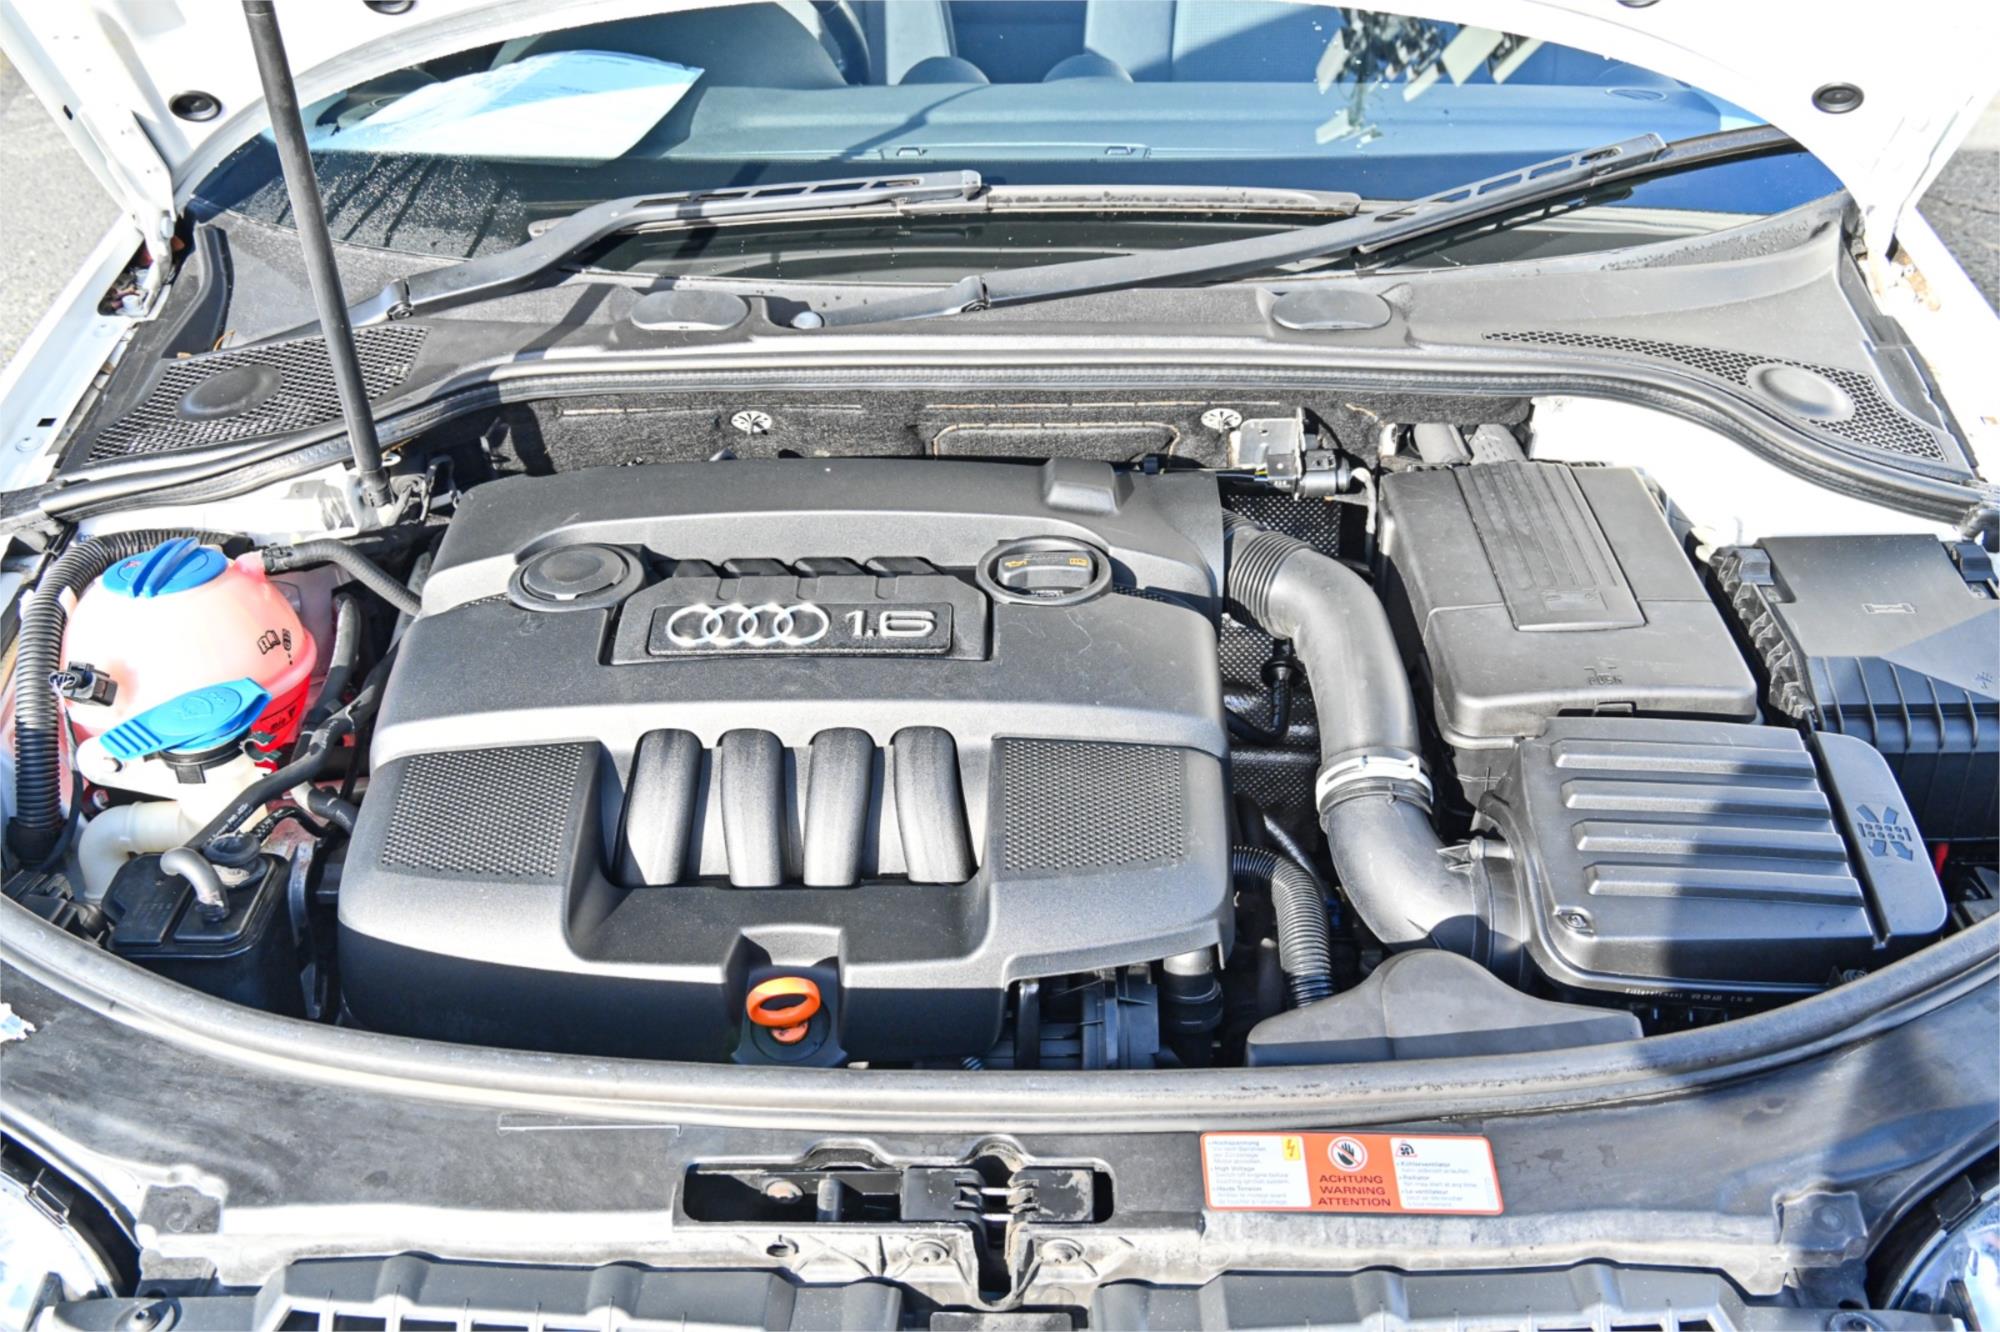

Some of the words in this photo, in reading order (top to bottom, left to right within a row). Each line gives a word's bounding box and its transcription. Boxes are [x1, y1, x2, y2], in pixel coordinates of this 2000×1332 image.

[845, 609, 936, 638] 1.6
[1319, 1174, 1383, 1184] ACHTUNG
[1319, 1186, 1386, 1195] WARNING
[1318, 1197, 1391, 1207] ATTENTION
